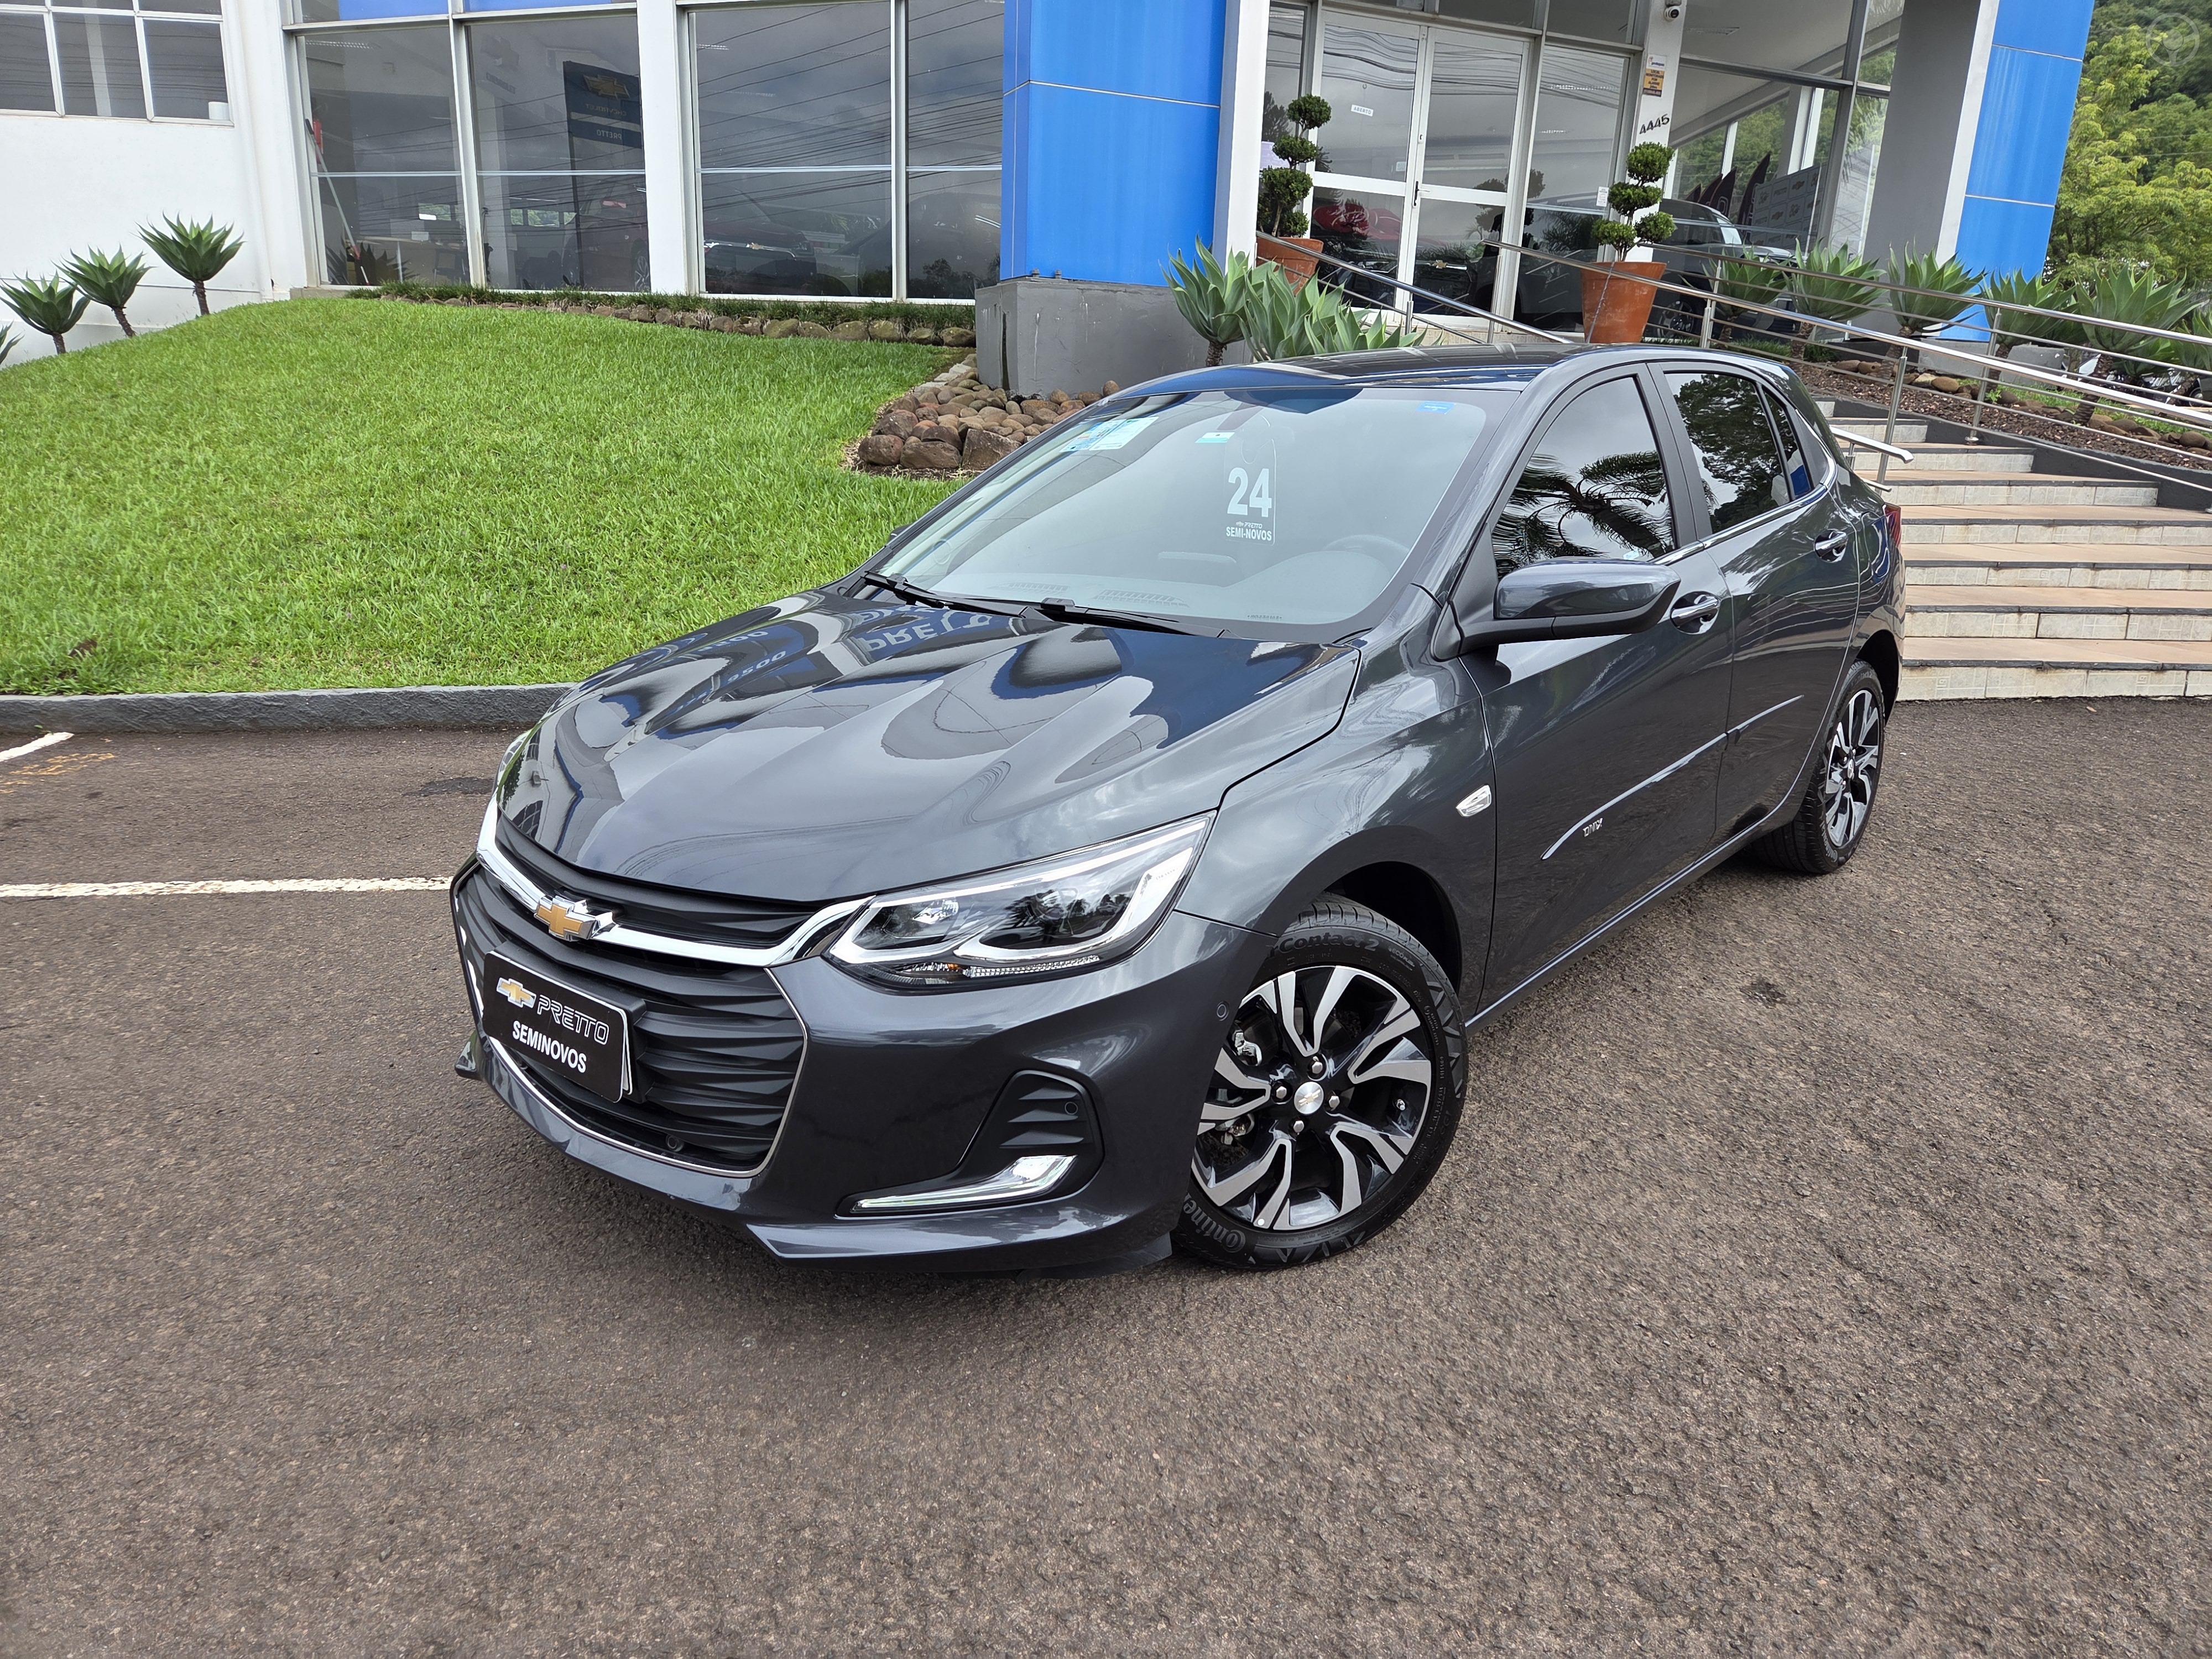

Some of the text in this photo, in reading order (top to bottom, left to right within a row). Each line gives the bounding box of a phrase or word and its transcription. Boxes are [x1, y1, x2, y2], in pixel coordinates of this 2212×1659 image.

[1354, 106, 1371, 114] ABERTO
[1639, 113, 1670, 134] 4445
[1227, 467, 1272, 518] 24
[1226, 526, 1272, 541] SEMI-NOVOS
[1364, 938, 1380, 952] 2
[538, 994, 609, 1045] PRETTO
[512, 1020, 587, 1073] SEMINOVOS
